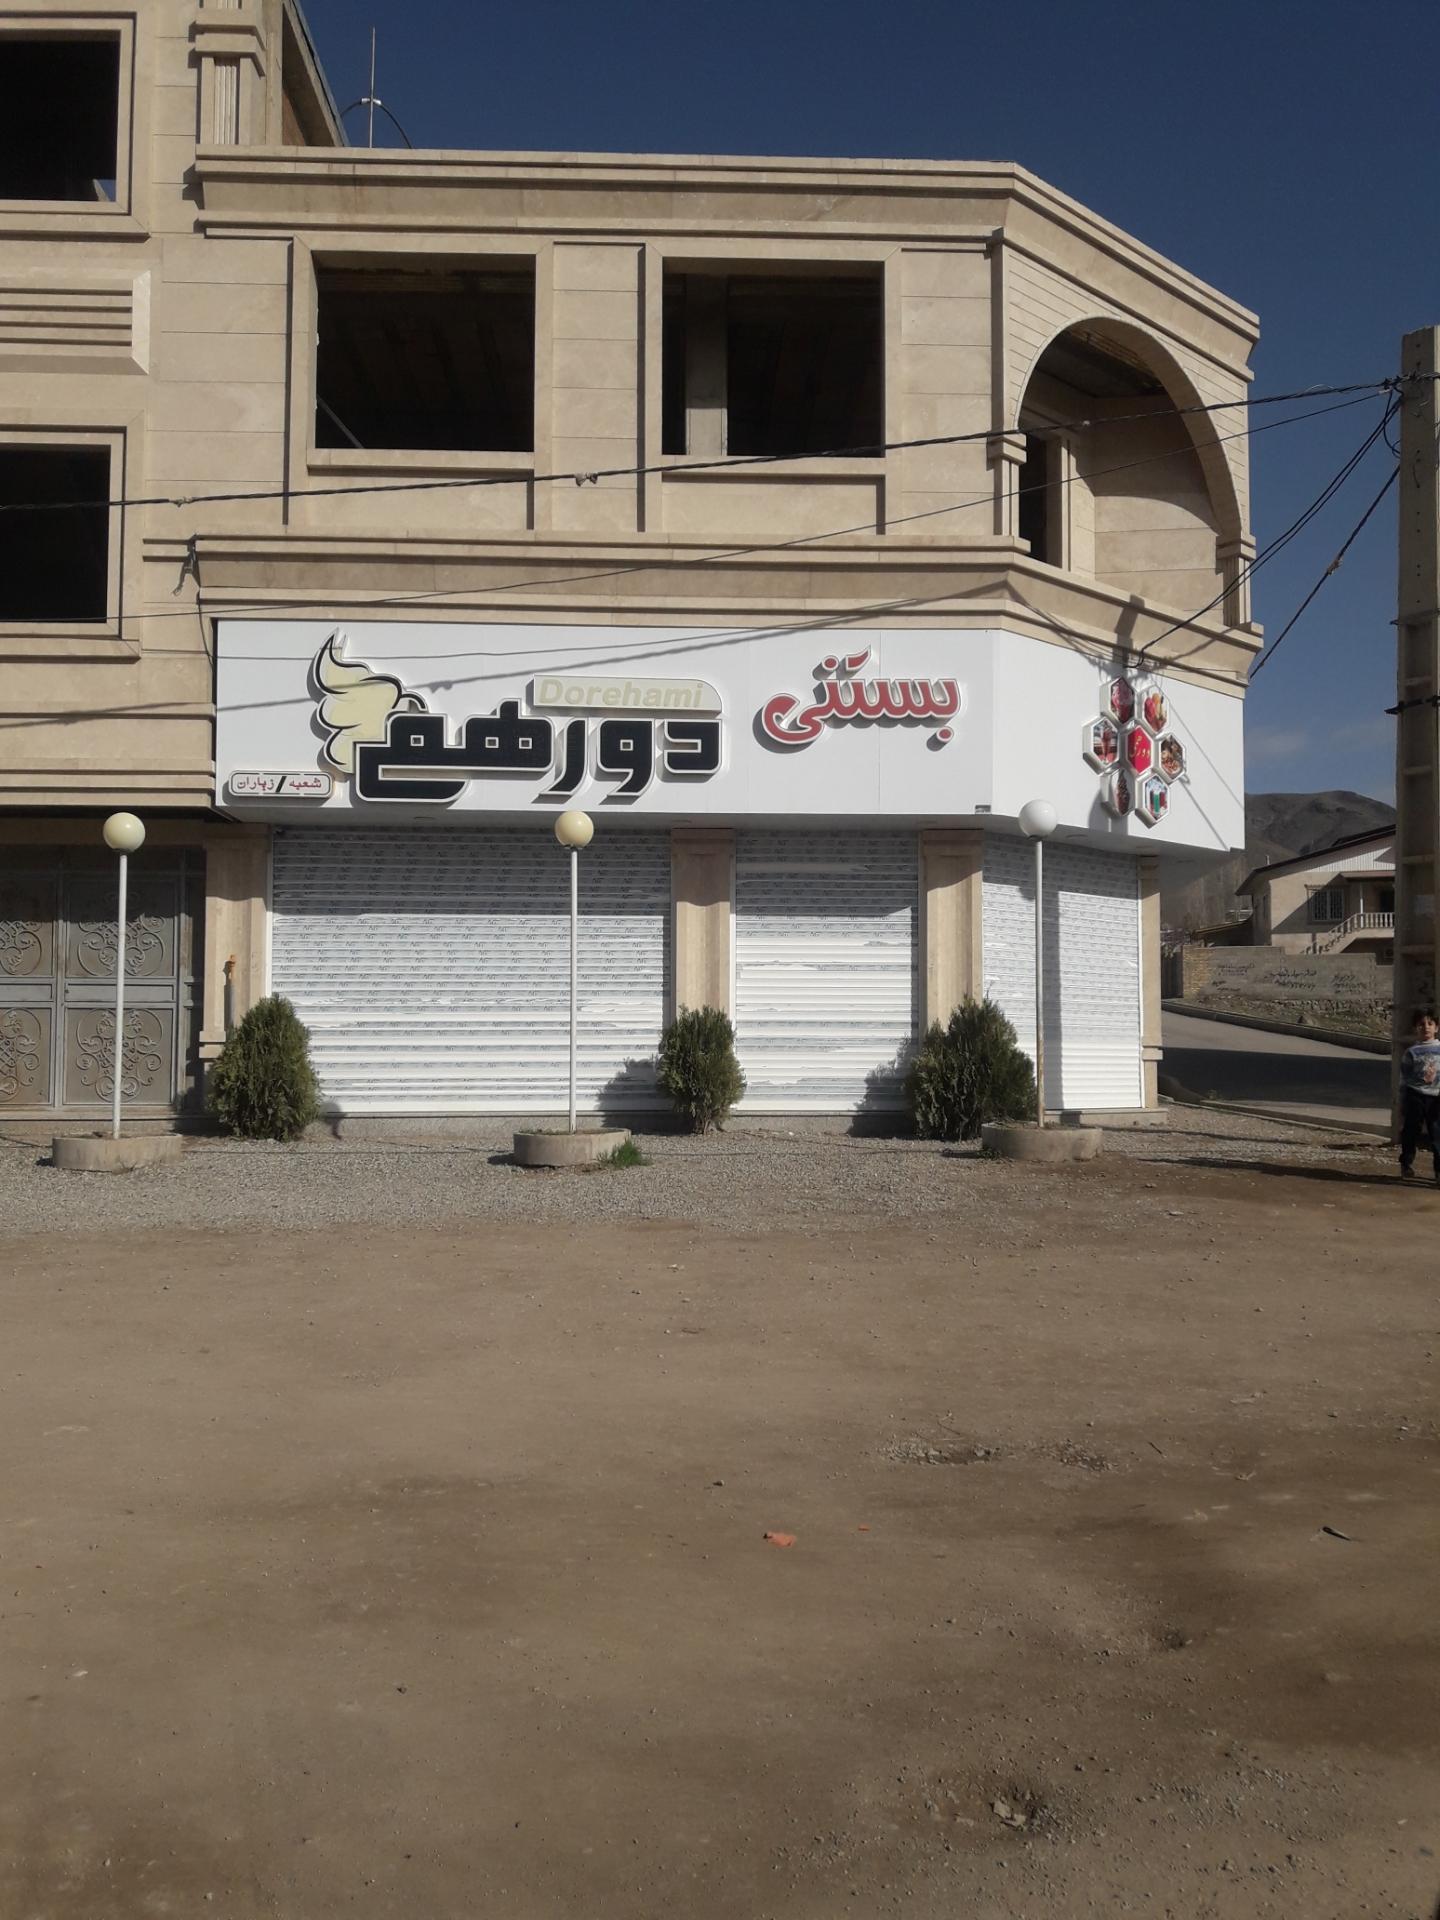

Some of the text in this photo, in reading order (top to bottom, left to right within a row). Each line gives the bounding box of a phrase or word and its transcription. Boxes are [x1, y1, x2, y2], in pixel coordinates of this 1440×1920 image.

[539, 678, 704, 708] Dorehami
[761, 645, 961, 744] بستنی
[357, 698, 722, 802] دورهمی
[289, 777, 322, 790] شعبه
